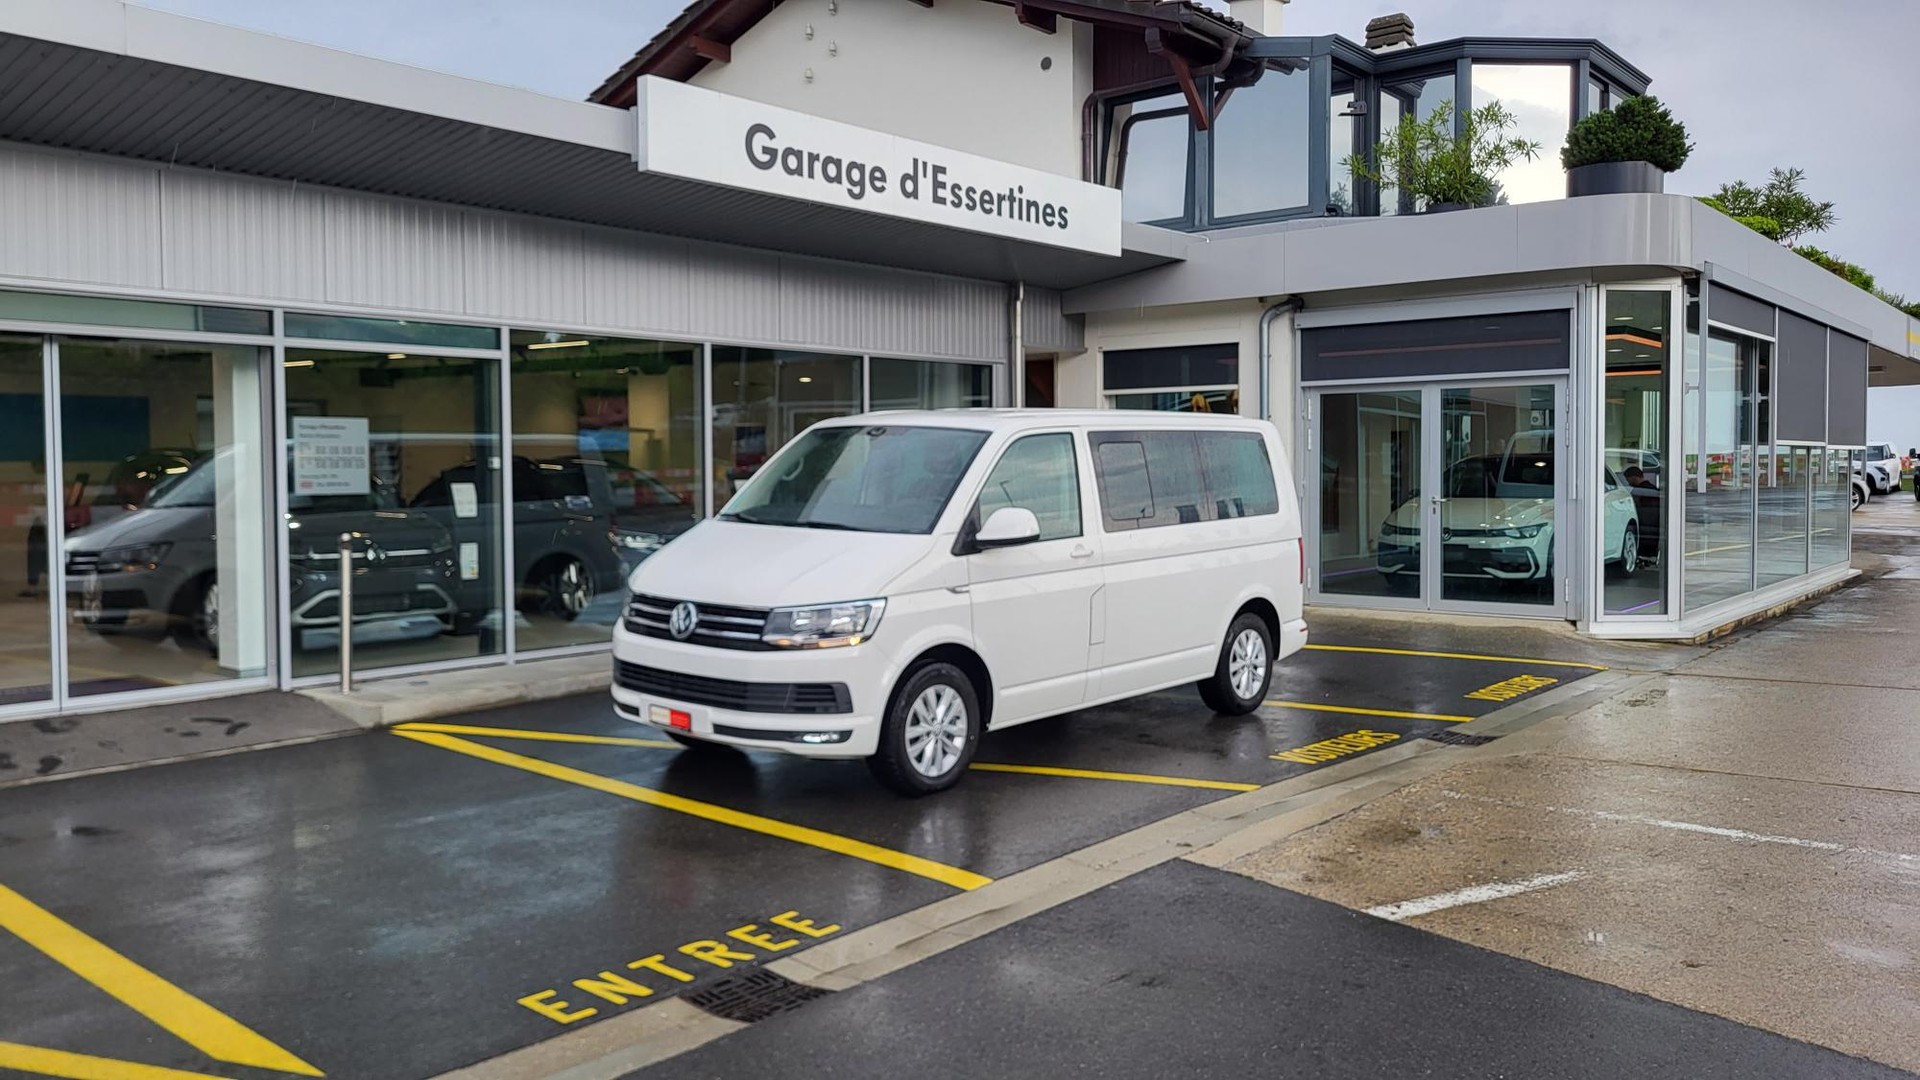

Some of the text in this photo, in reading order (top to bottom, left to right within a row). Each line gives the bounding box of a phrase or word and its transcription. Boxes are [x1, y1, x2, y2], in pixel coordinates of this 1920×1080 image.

[744, 122, 1069, 230] Garage d'Essertines
[1268, 729, 1401, 765] VISITEURS
[516, 910, 842, 1025] ENTREE
